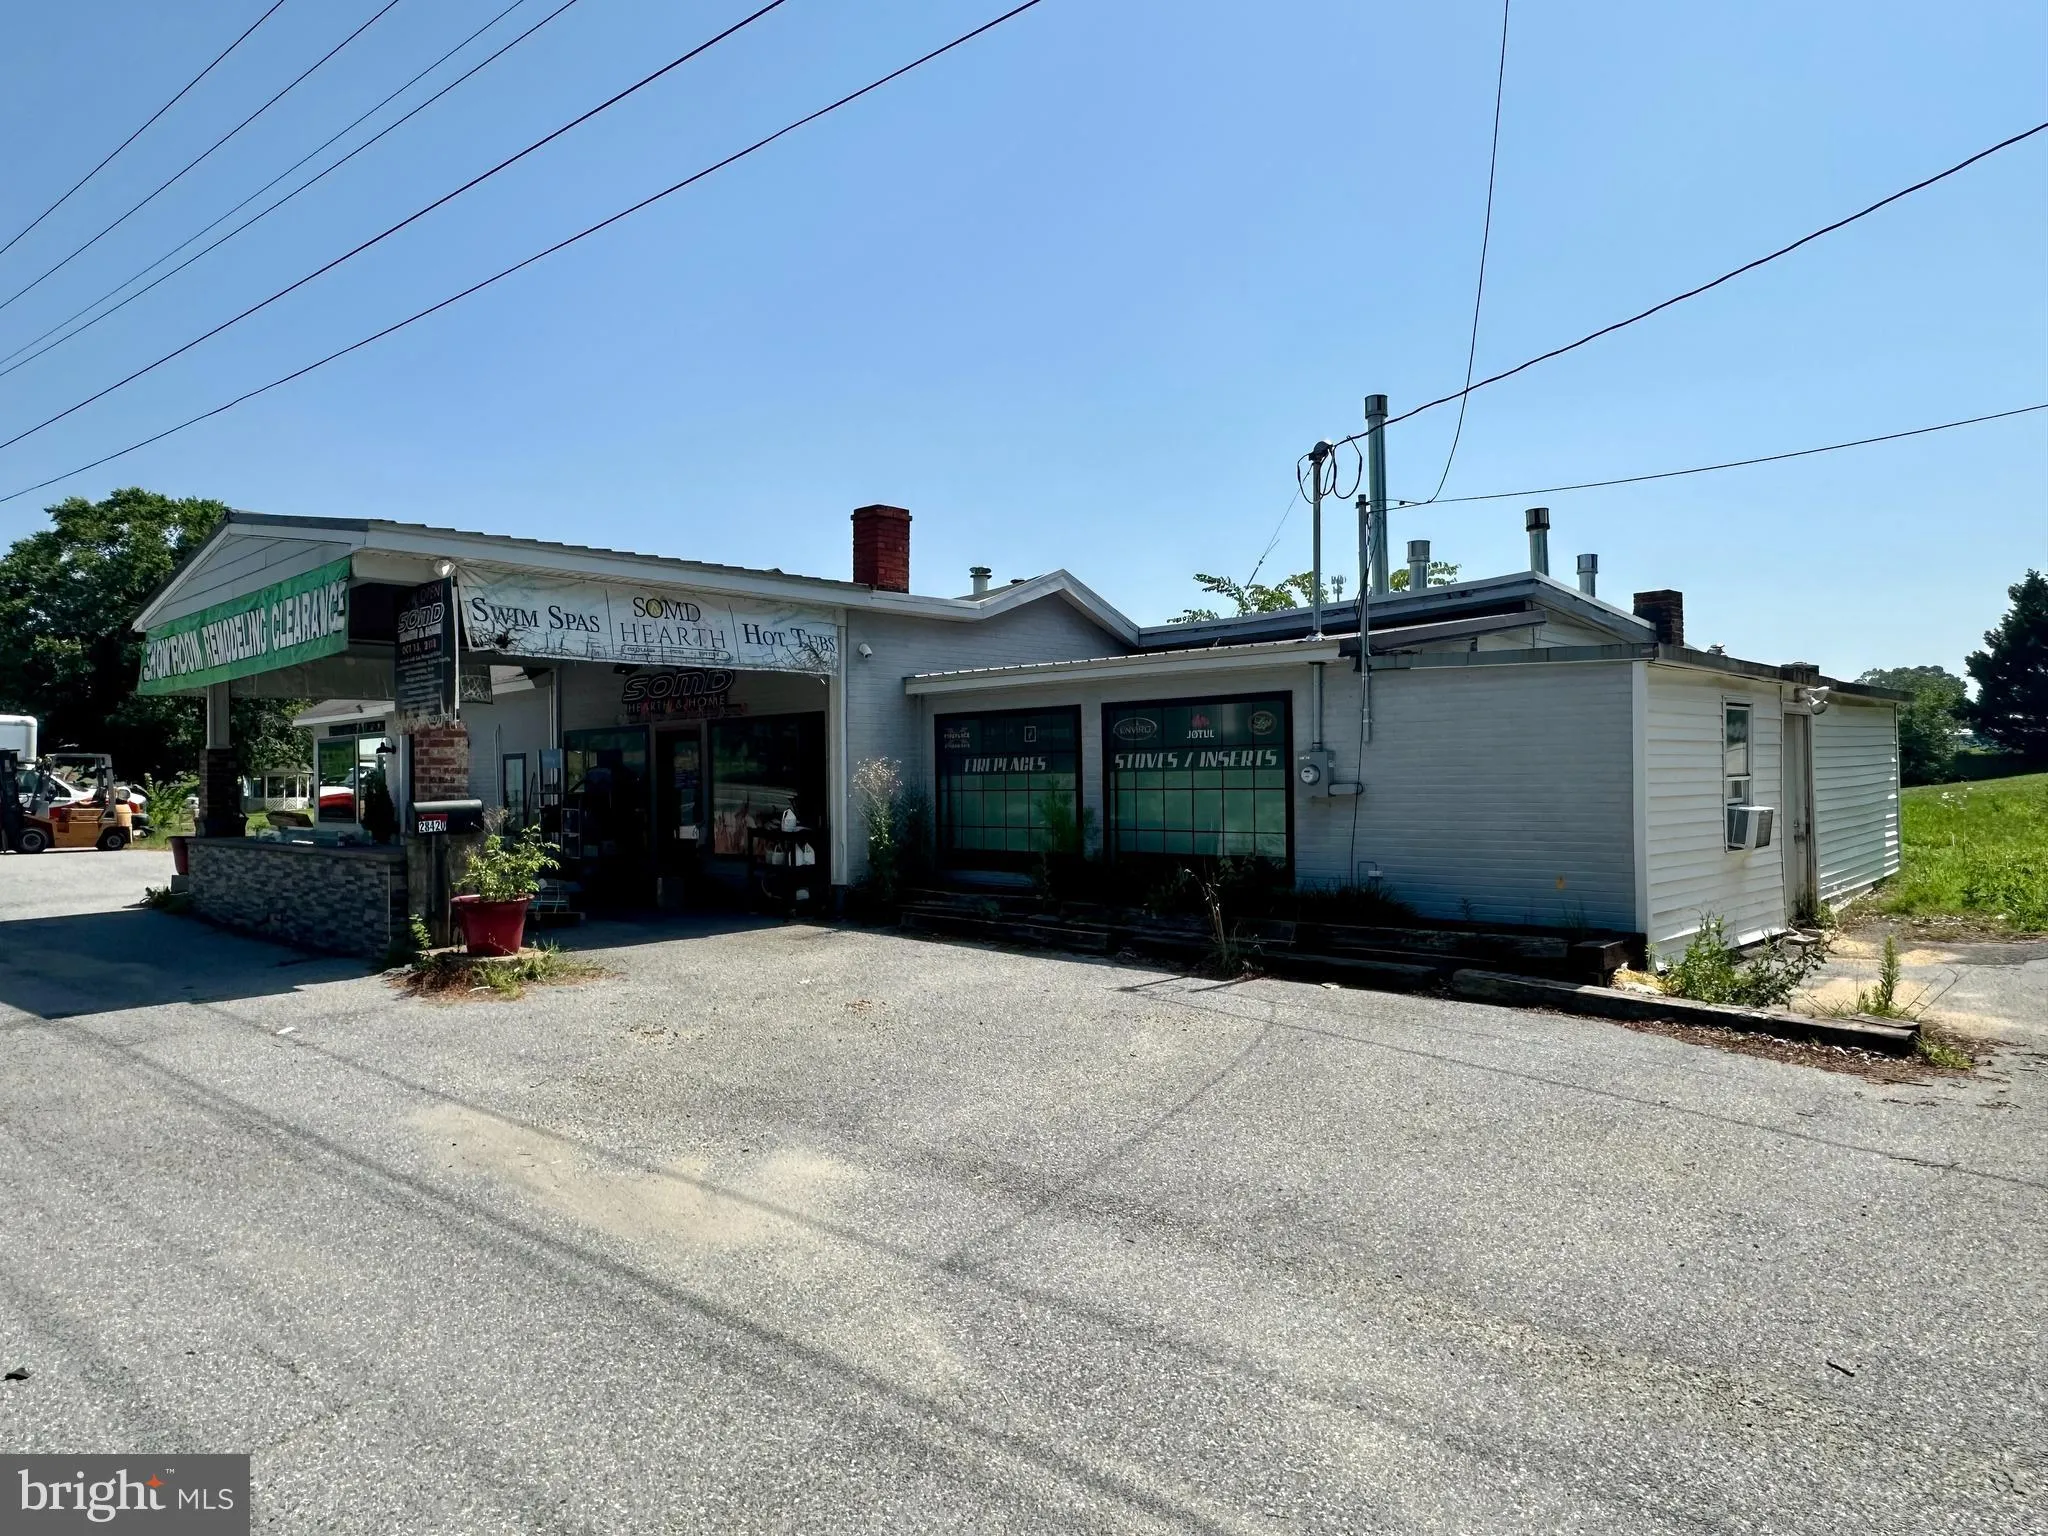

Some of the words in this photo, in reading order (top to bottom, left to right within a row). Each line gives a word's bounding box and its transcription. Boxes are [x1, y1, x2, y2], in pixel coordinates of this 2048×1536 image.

[633, 596, 702, 623] SOMD
[143, 634, 202, 682] SHOWROOM
[202, 608, 267, 668] REMODELING
[272, 580, 348, 651] CLEARANCE
[621, 622, 726, 649] HEARTH
[622, 669, 734, 702] SOMD
[628, 699, 668, 713] HEARTH
[688, 695, 726, 707] HOME
[964, 756, 1047, 773] FIREPLACES
[1114, 751, 1178, 769] STOVES
[1199, 749, 1278, 768] INSERTS
